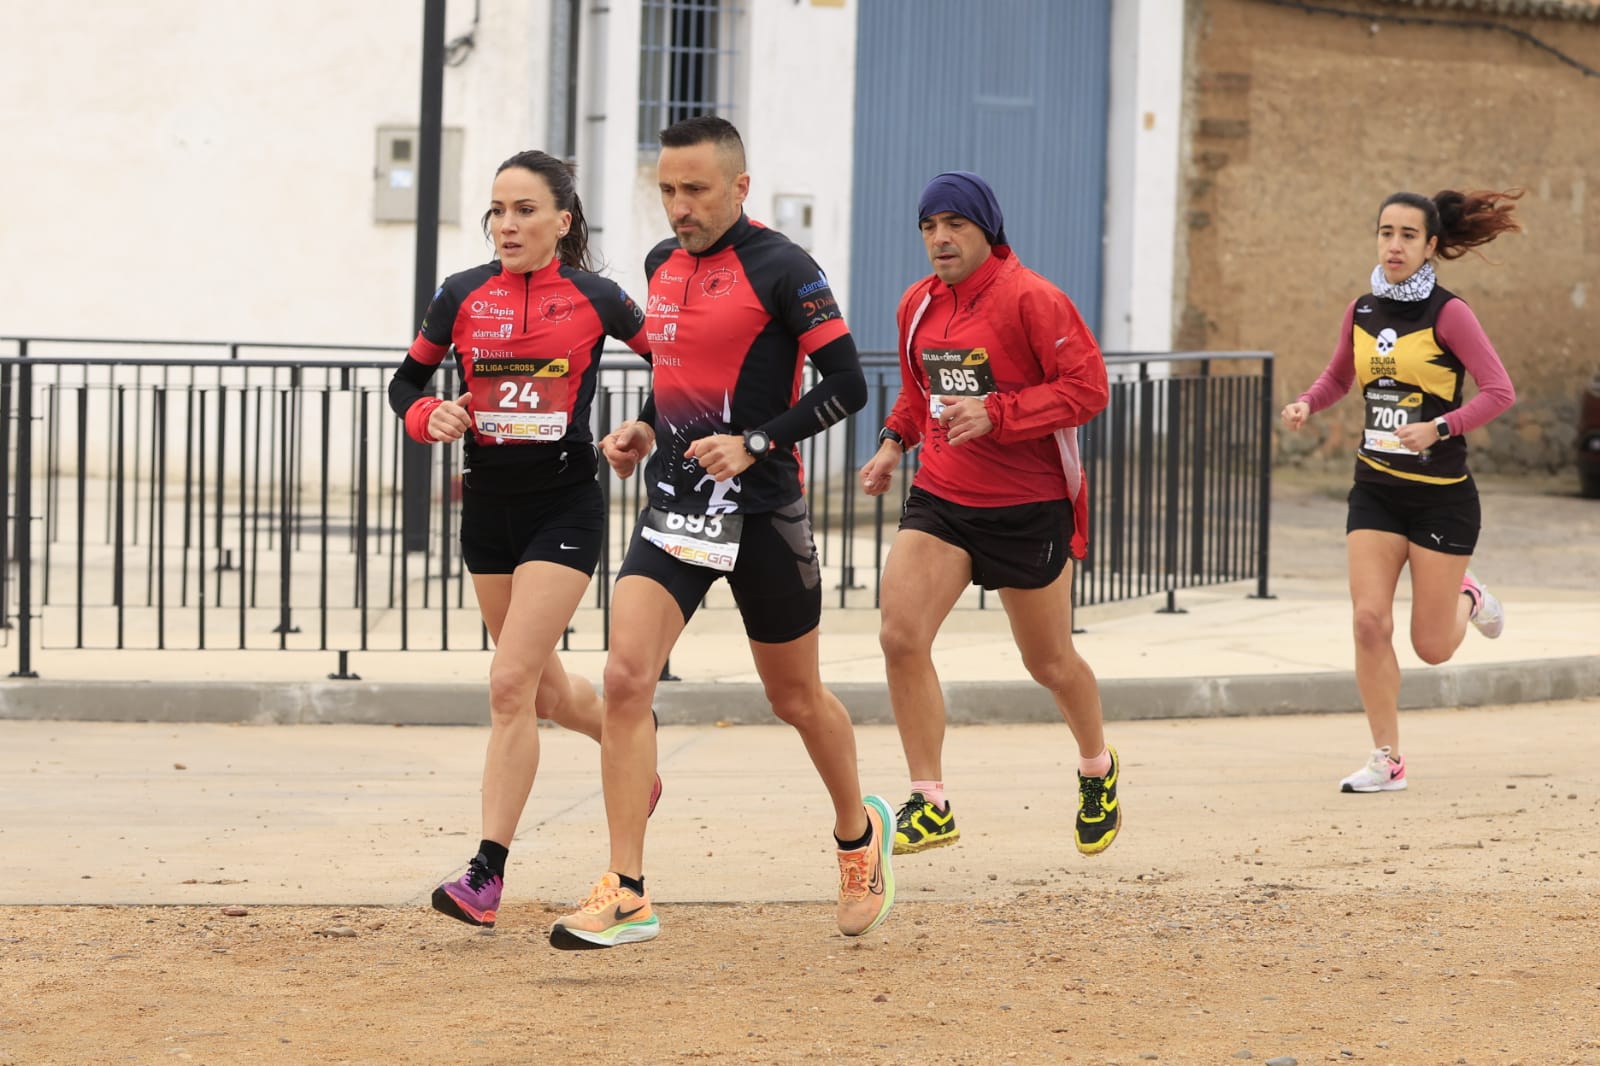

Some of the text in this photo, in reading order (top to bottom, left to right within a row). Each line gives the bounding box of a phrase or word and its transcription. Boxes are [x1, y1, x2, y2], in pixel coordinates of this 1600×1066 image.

[490, 307, 514, 316] tapia
[481, 348, 516, 358] DANIEL
[475, 364, 485, 372] 33
[486, 364, 503, 372] LIGA
[509, 364, 535, 372] CROSS
[1371, 367, 1397, 376] CROSS
[939, 368, 979, 392] 695
[499, 381, 540, 409] 24
[1372, 406, 1408, 429] 700
[479, 421, 563, 436] JOMISAGA
[666, 511, 725, 538] 693
